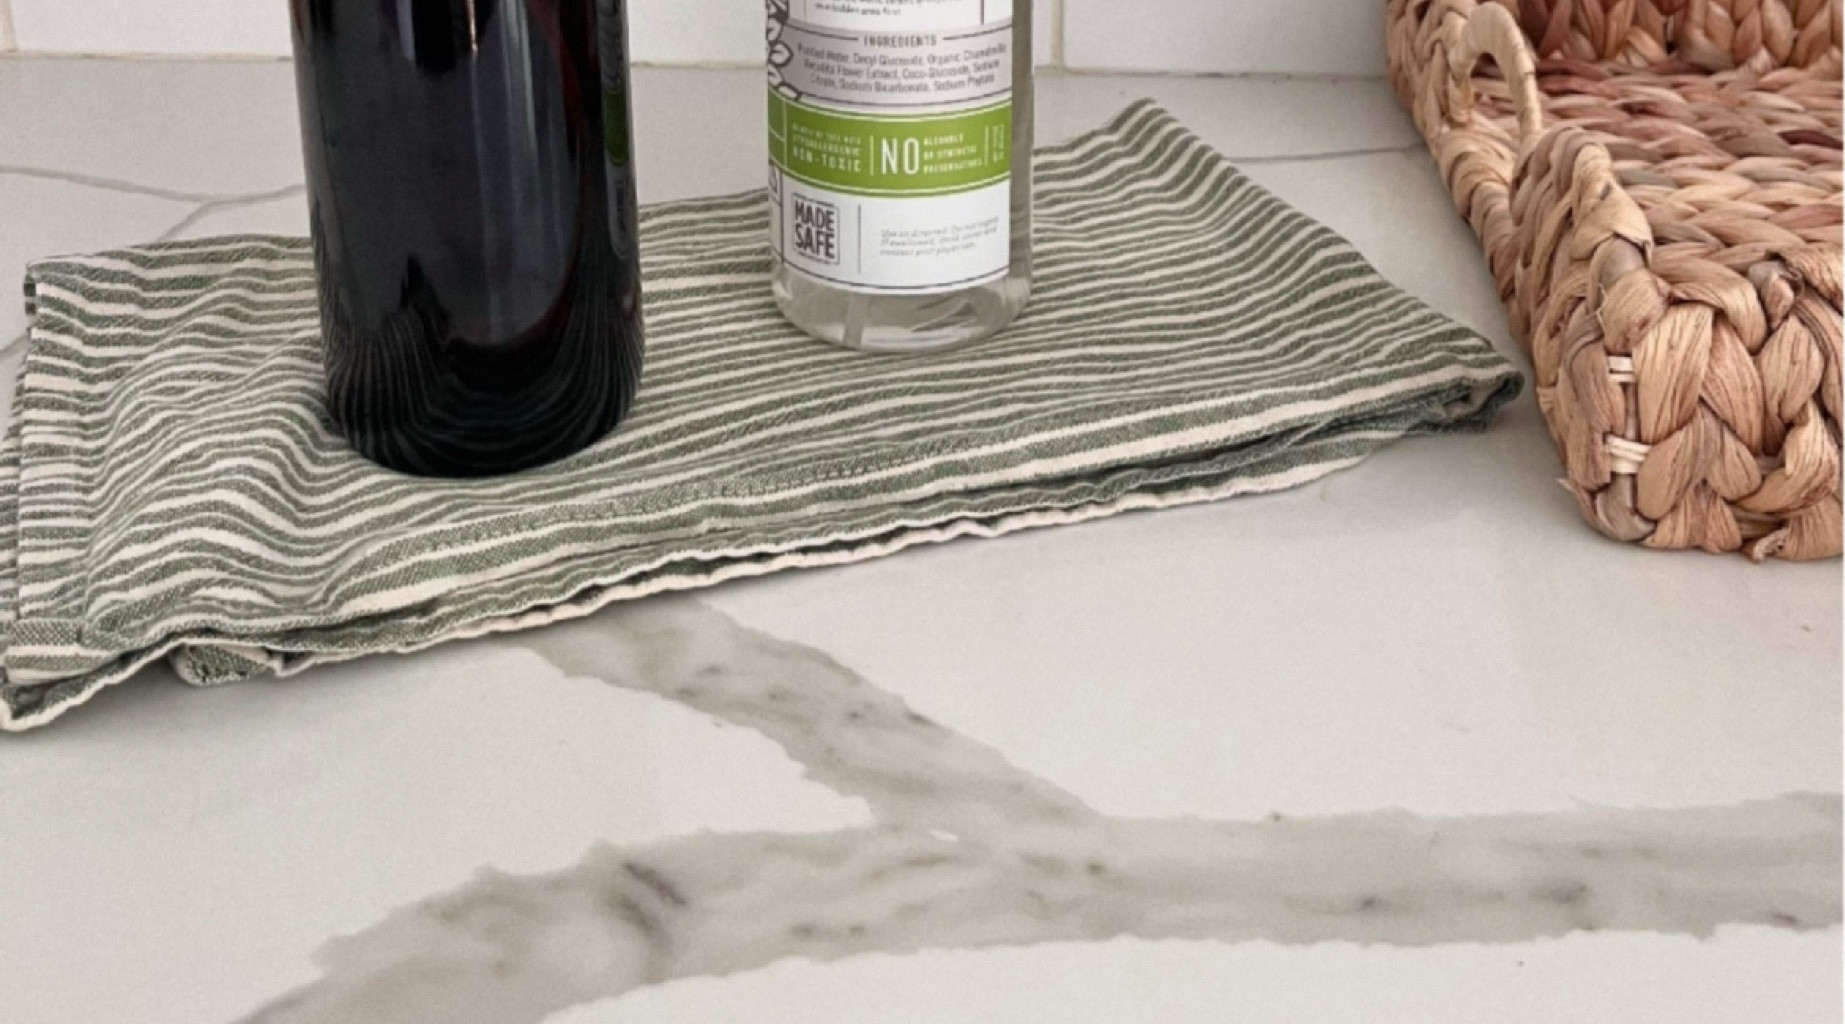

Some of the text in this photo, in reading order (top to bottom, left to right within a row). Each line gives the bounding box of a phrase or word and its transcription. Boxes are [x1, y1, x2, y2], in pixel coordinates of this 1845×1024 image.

[863, 34, 937, 49] INGREDIENTS
[882, 137, 920, 175] NO
[795, 199, 835, 232] MADE
[795, 222, 835, 260] SAFE
